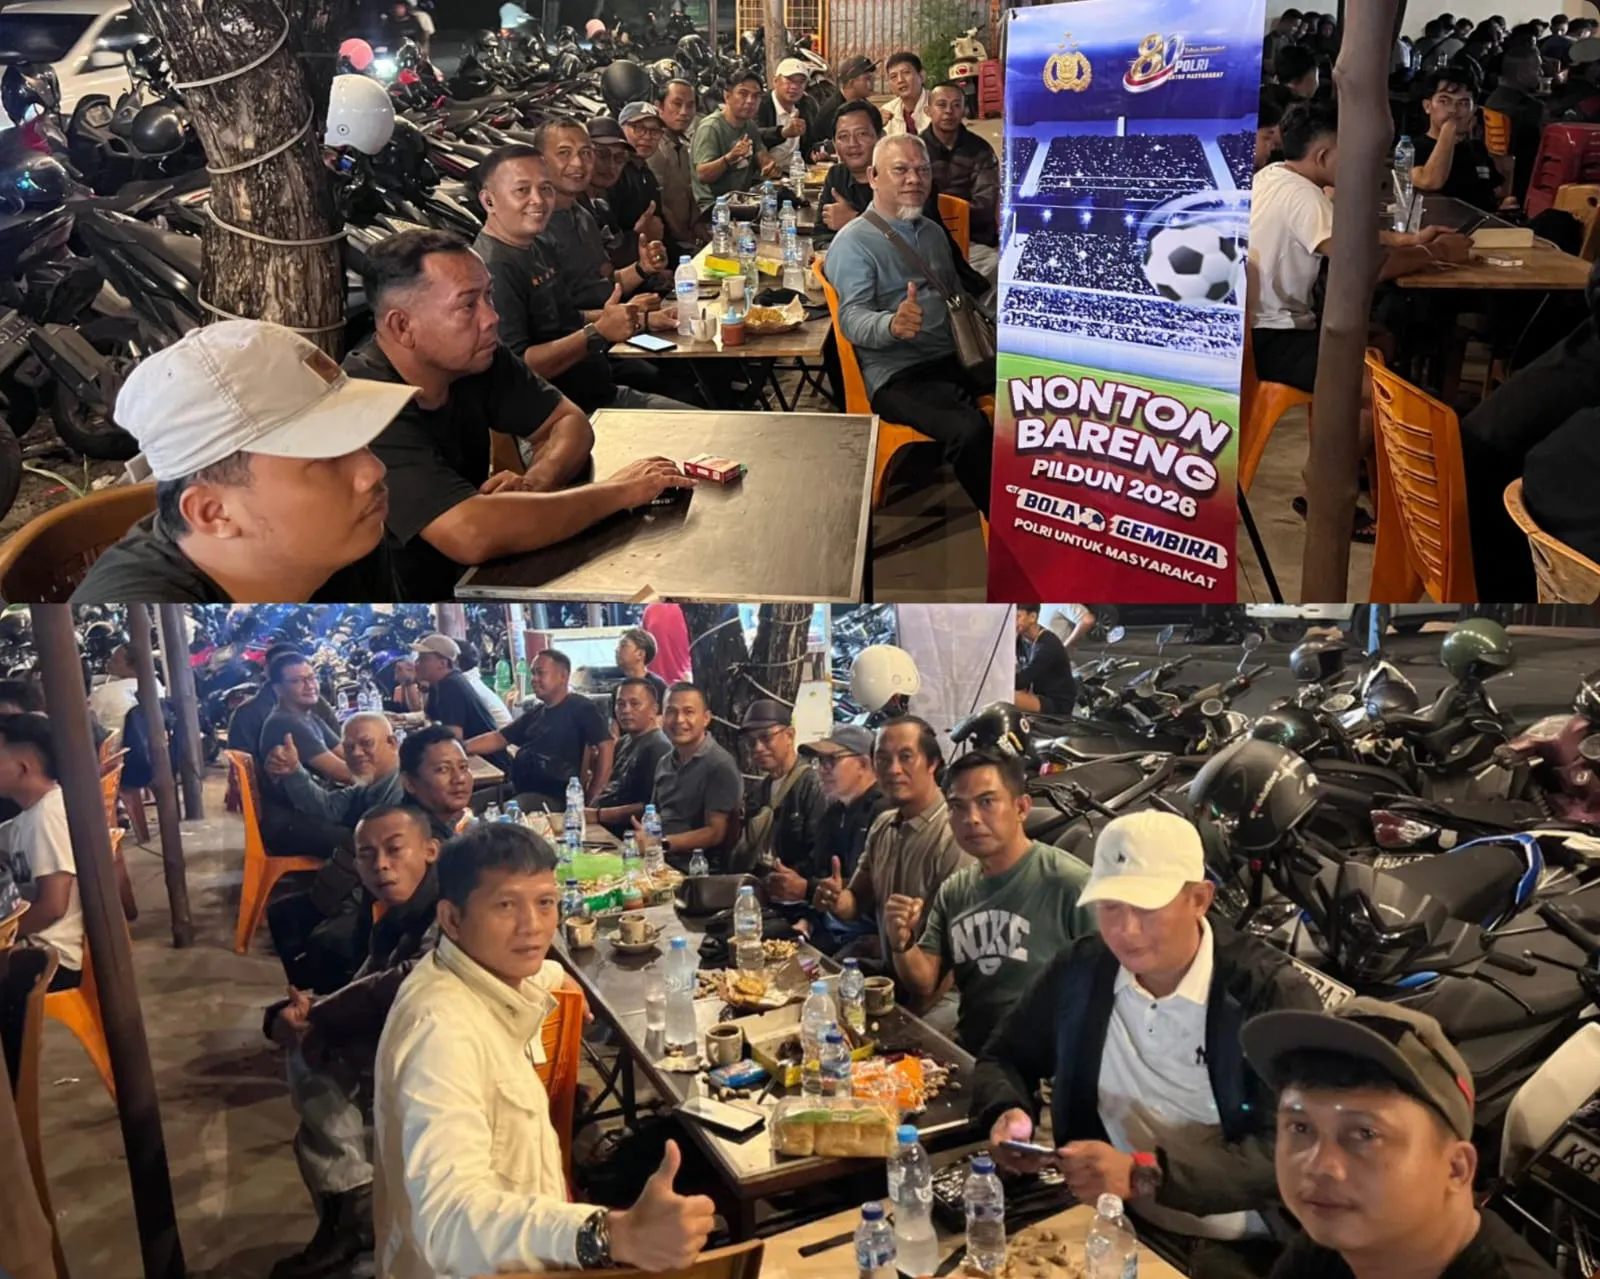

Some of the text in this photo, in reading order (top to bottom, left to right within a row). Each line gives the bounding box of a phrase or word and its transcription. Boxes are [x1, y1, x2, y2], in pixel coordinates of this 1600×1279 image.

[1174, 58, 1210, 73] POLRI
[1009, 375, 1232, 453] NONTON
[1017, 418, 1218, 492] BARENG
[1032, 459, 1198, 518] PILDUN 2026
[1014, 518, 1218, 590] POLRI UNTUK MASYARAKAT
[1024, 493, 1219, 564] BOLA GEMBIRA
[951, 909, 1031, 965] NIKE
